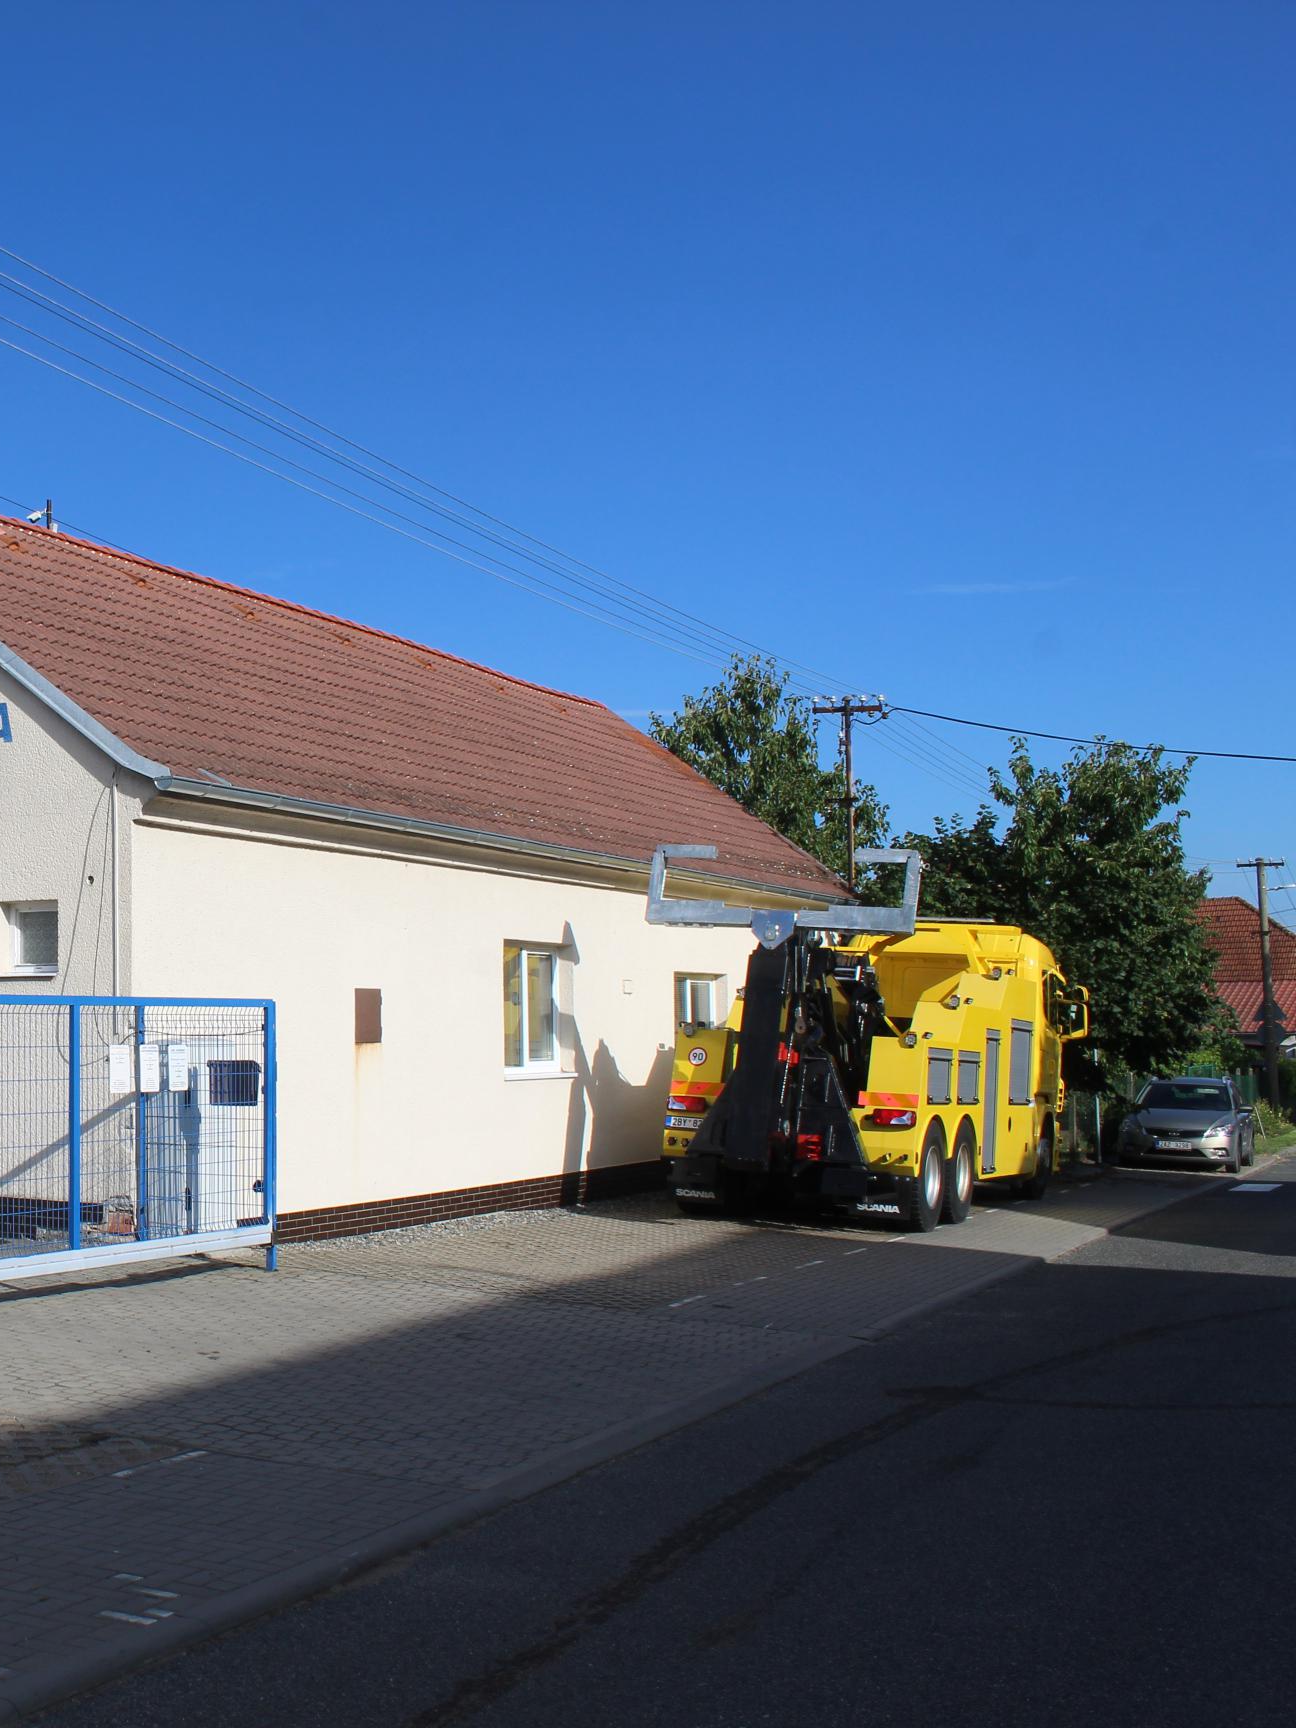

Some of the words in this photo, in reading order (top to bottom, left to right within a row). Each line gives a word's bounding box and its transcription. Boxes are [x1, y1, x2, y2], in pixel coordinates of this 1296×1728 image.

[692, 1052, 704, 1062] 90
[675, 1188, 716, 1199] SCANIA
[856, 1203, 900, 1214] SCANIA
